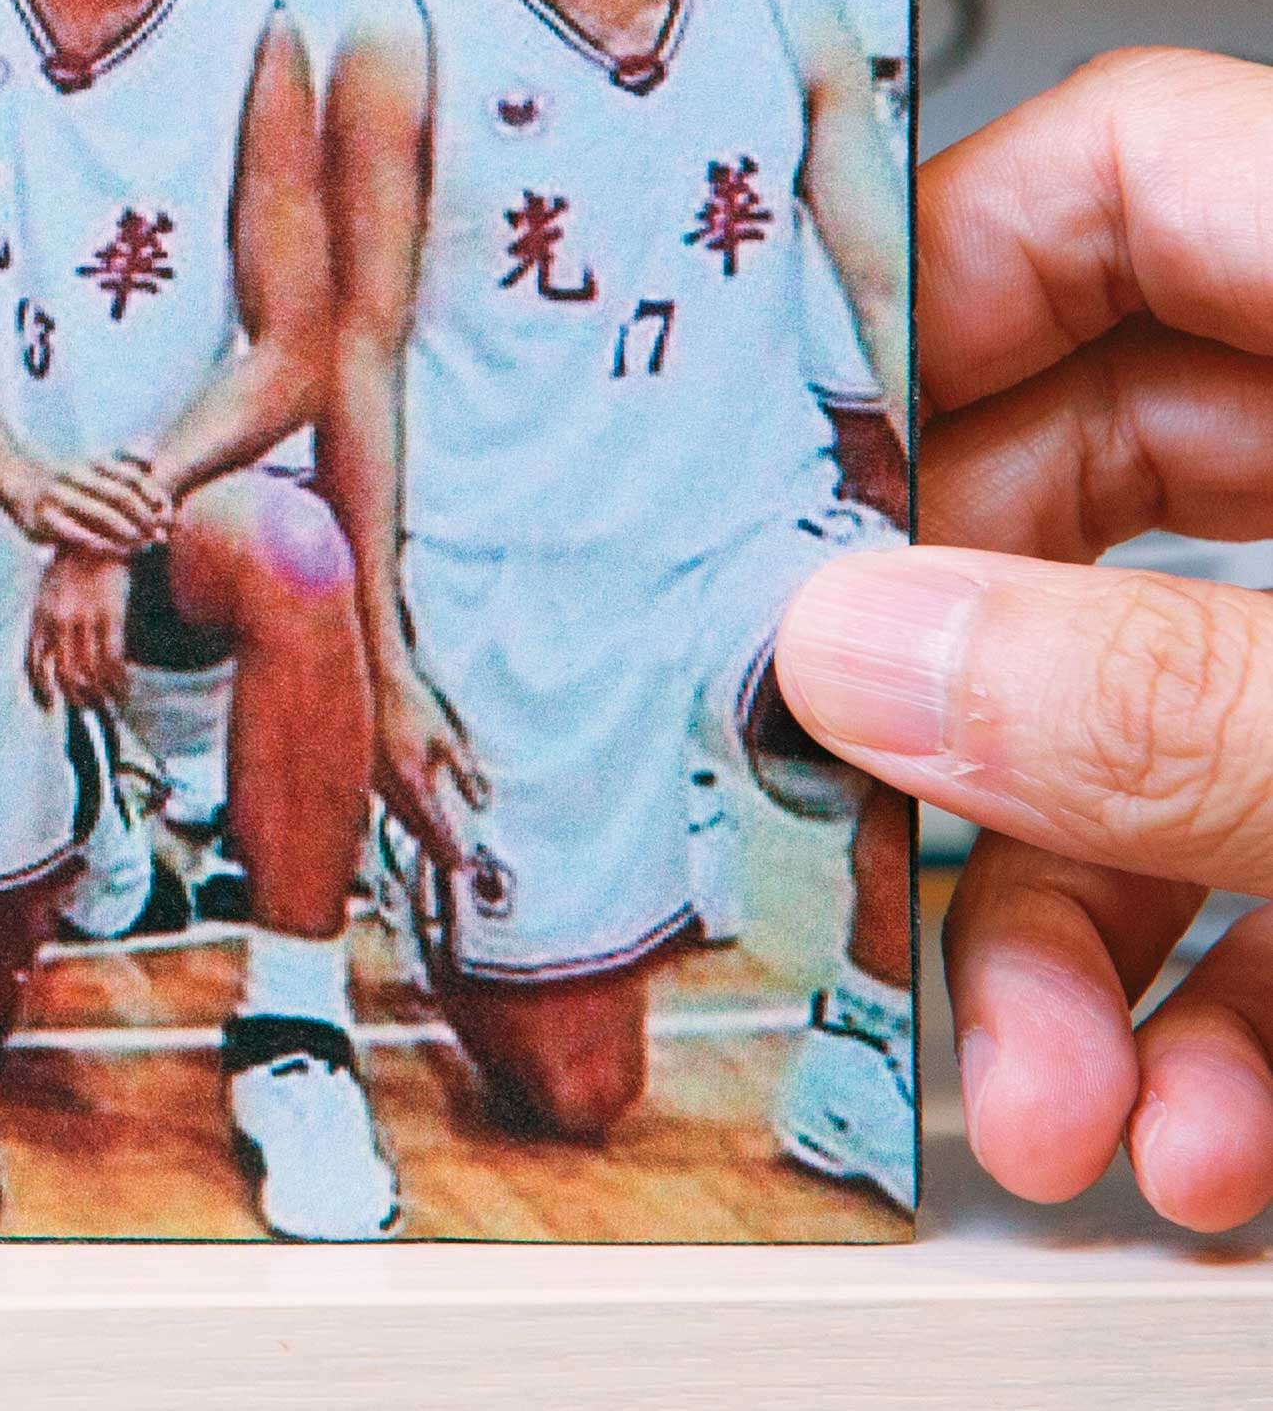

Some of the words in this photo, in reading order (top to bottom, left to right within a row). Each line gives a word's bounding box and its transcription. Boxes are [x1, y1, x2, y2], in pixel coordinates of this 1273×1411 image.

[74, 206, 176, 322] 華
[498, 189, 598, 302] 光
[683, 154, 774, 278] 華
[609, 298, 676, 380] 17
